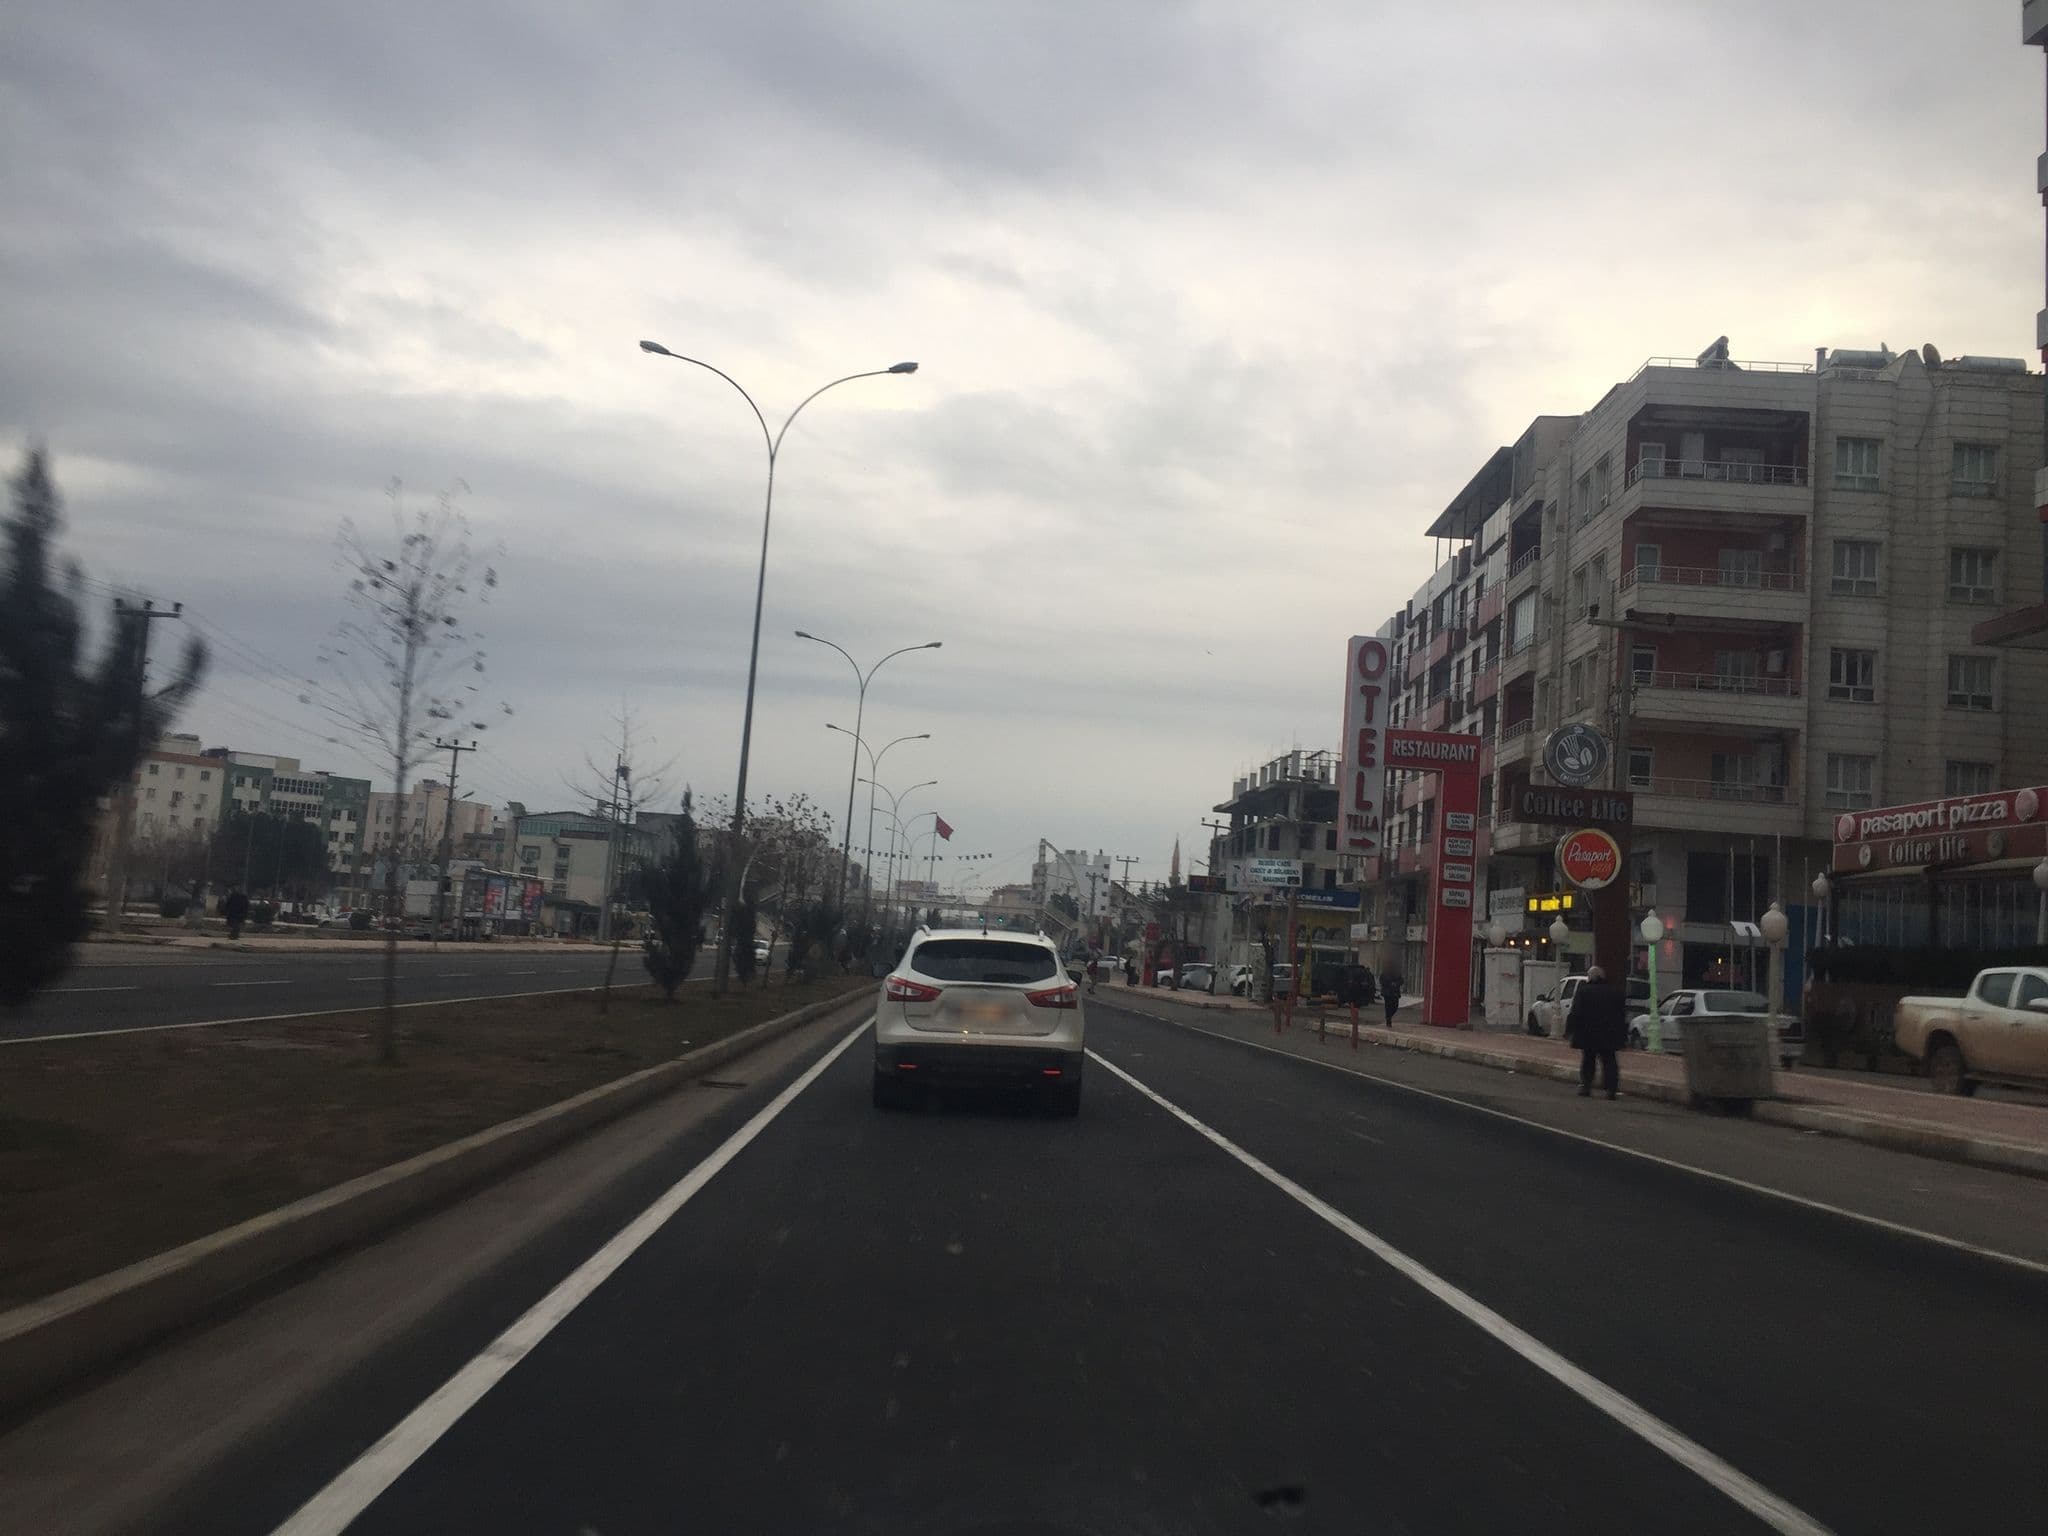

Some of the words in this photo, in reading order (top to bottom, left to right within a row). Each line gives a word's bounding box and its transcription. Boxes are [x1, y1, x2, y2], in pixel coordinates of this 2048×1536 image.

[1355, 640, 1387, 810] OTEL
[1391, 738, 1477, 762] RESTAURANT
[1522, 791, 1584, 818] Coffee
[1591, 798, 1629, 822] Life
[1861, 802, 1945, 840] pasaport
[1949, 797, 2009, 829] pizza
[1567, 842, 1612, 866] Pasaport
[1888, 840, 1932, 864] Coffee
[1939, 836, 1966, 861] Life
